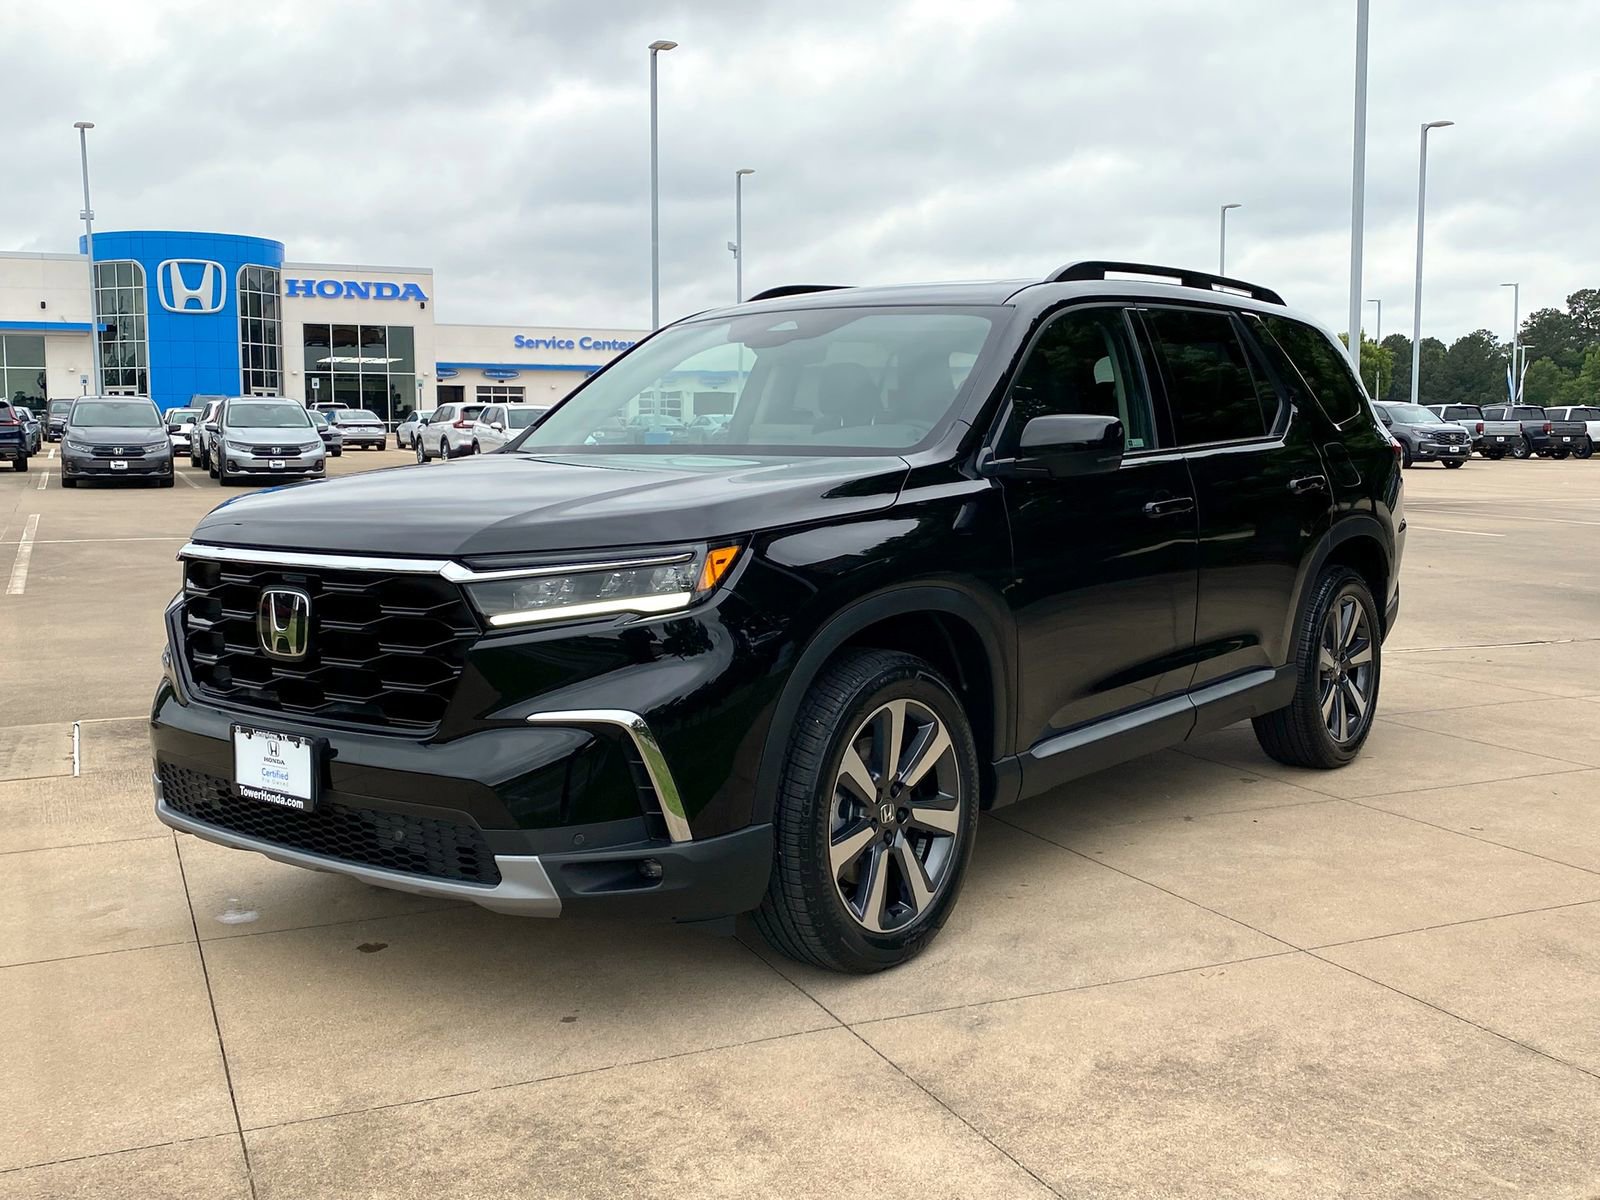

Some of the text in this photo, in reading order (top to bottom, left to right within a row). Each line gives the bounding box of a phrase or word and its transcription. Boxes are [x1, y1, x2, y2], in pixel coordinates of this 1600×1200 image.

[285, 279, 429, 301] HONDA
[514, 335, 636, 351] Service Center
[263, 756, 286, 766] HONDA
[261, 767, 289, 781] Certified
[239, 785, 304, 809] TowerHonda.com
